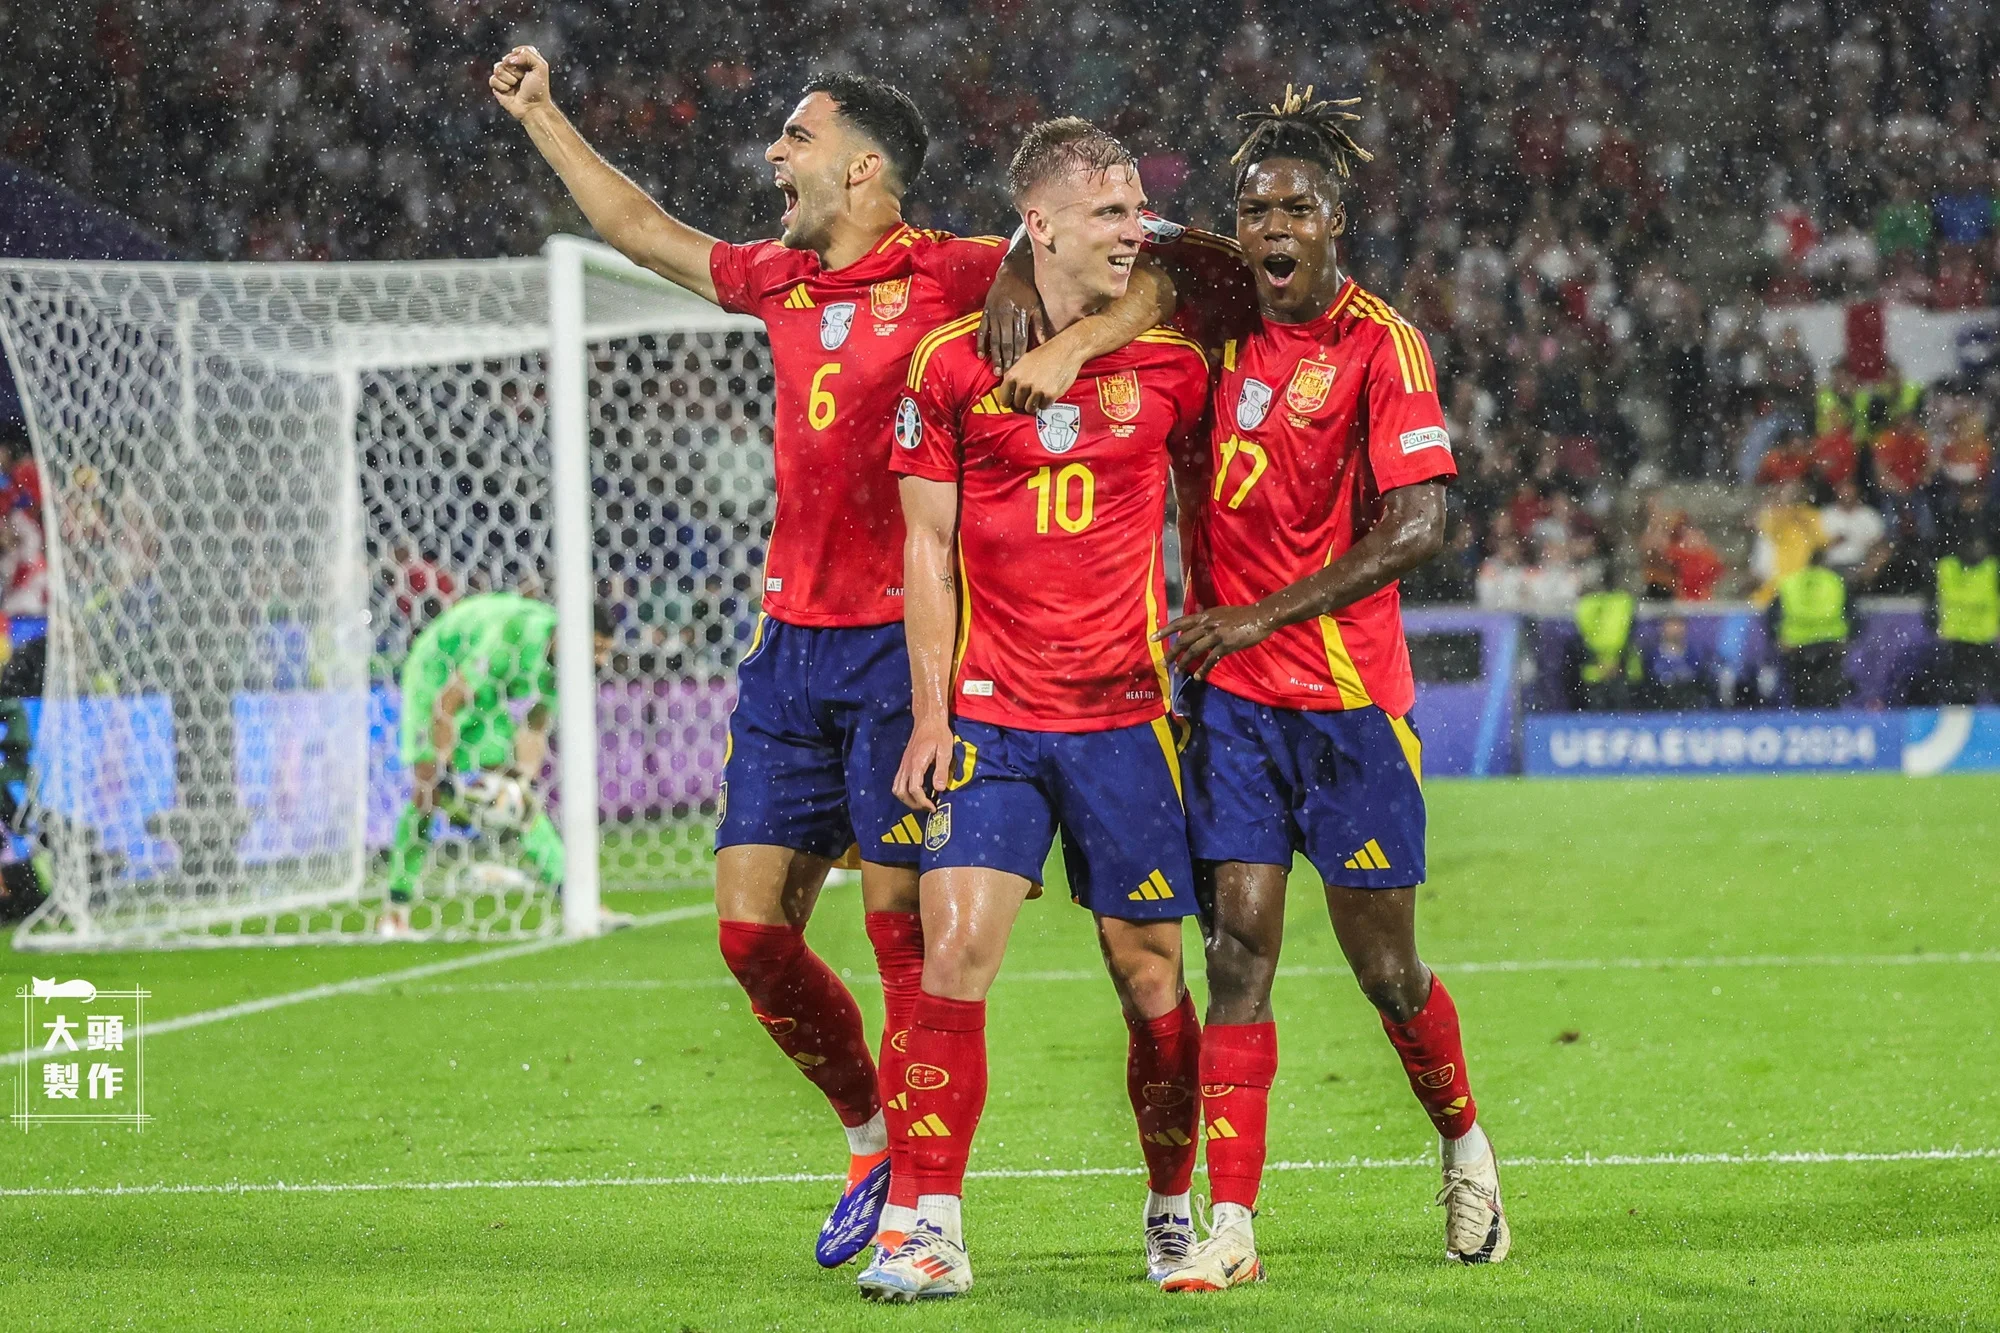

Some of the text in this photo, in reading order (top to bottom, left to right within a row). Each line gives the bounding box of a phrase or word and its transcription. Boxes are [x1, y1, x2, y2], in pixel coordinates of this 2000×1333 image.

[808, 363, 841, 431] 6
[1027, 462, 1095, 534] 10
[1213, 434, 1269, 510] 17
